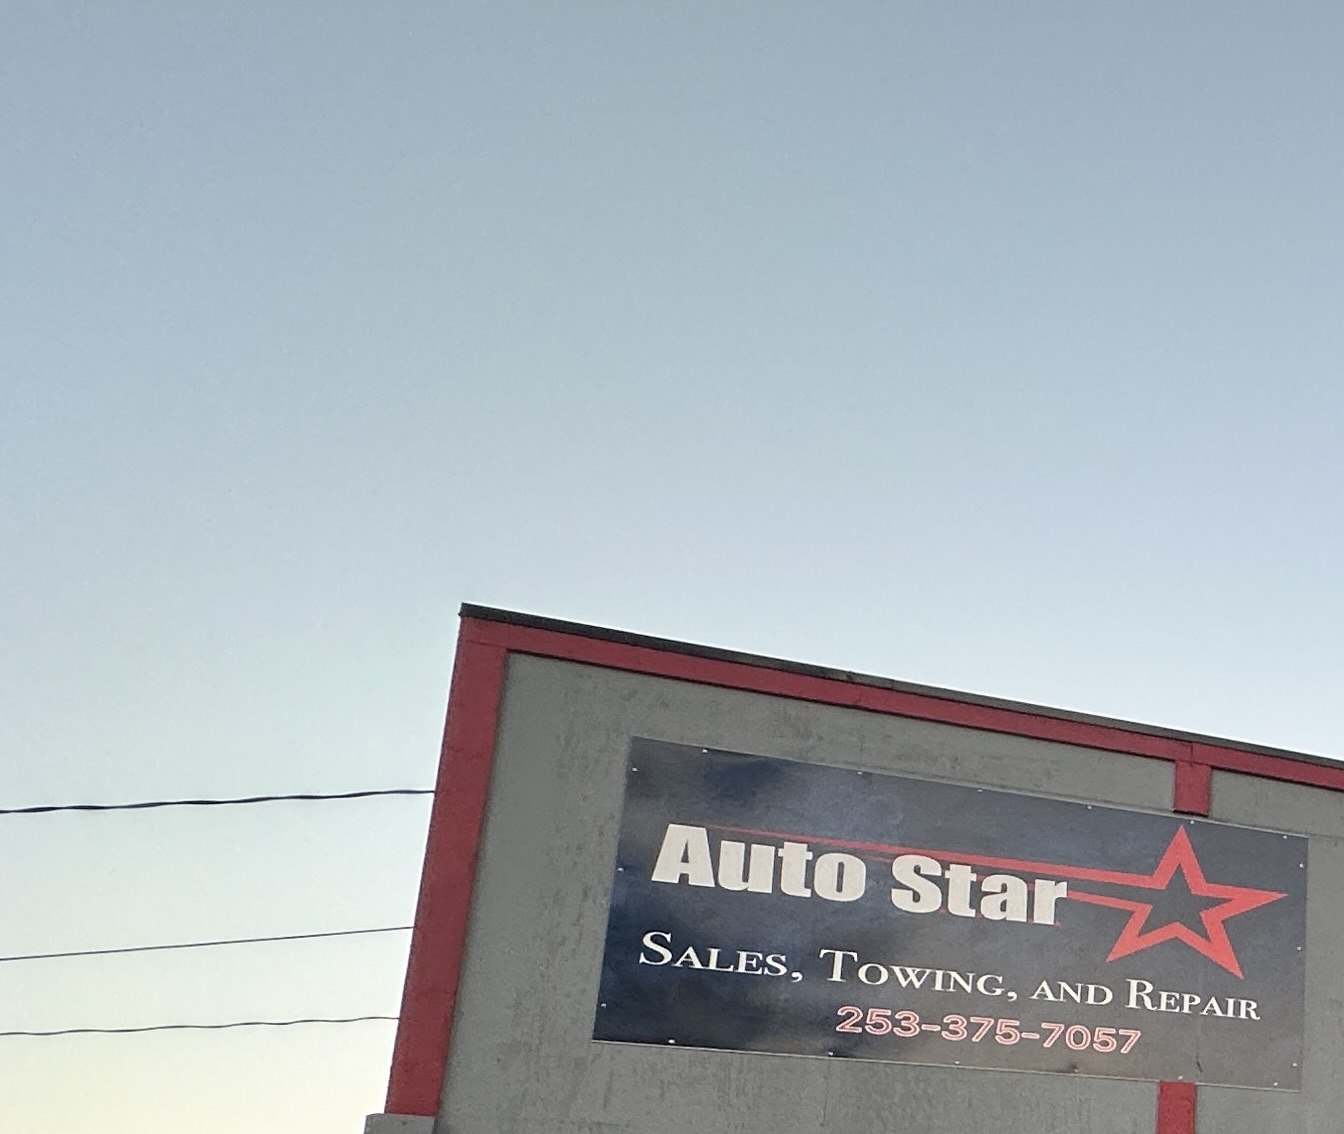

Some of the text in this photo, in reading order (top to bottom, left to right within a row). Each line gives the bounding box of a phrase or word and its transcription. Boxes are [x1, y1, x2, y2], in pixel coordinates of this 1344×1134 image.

[652, 823, 1068, 925] Auto Star
[639, 931, 1261, 1020] SALES, TOWING, AND REPAIR
[836, 1005, 1141, 1054] 253-375-7057
